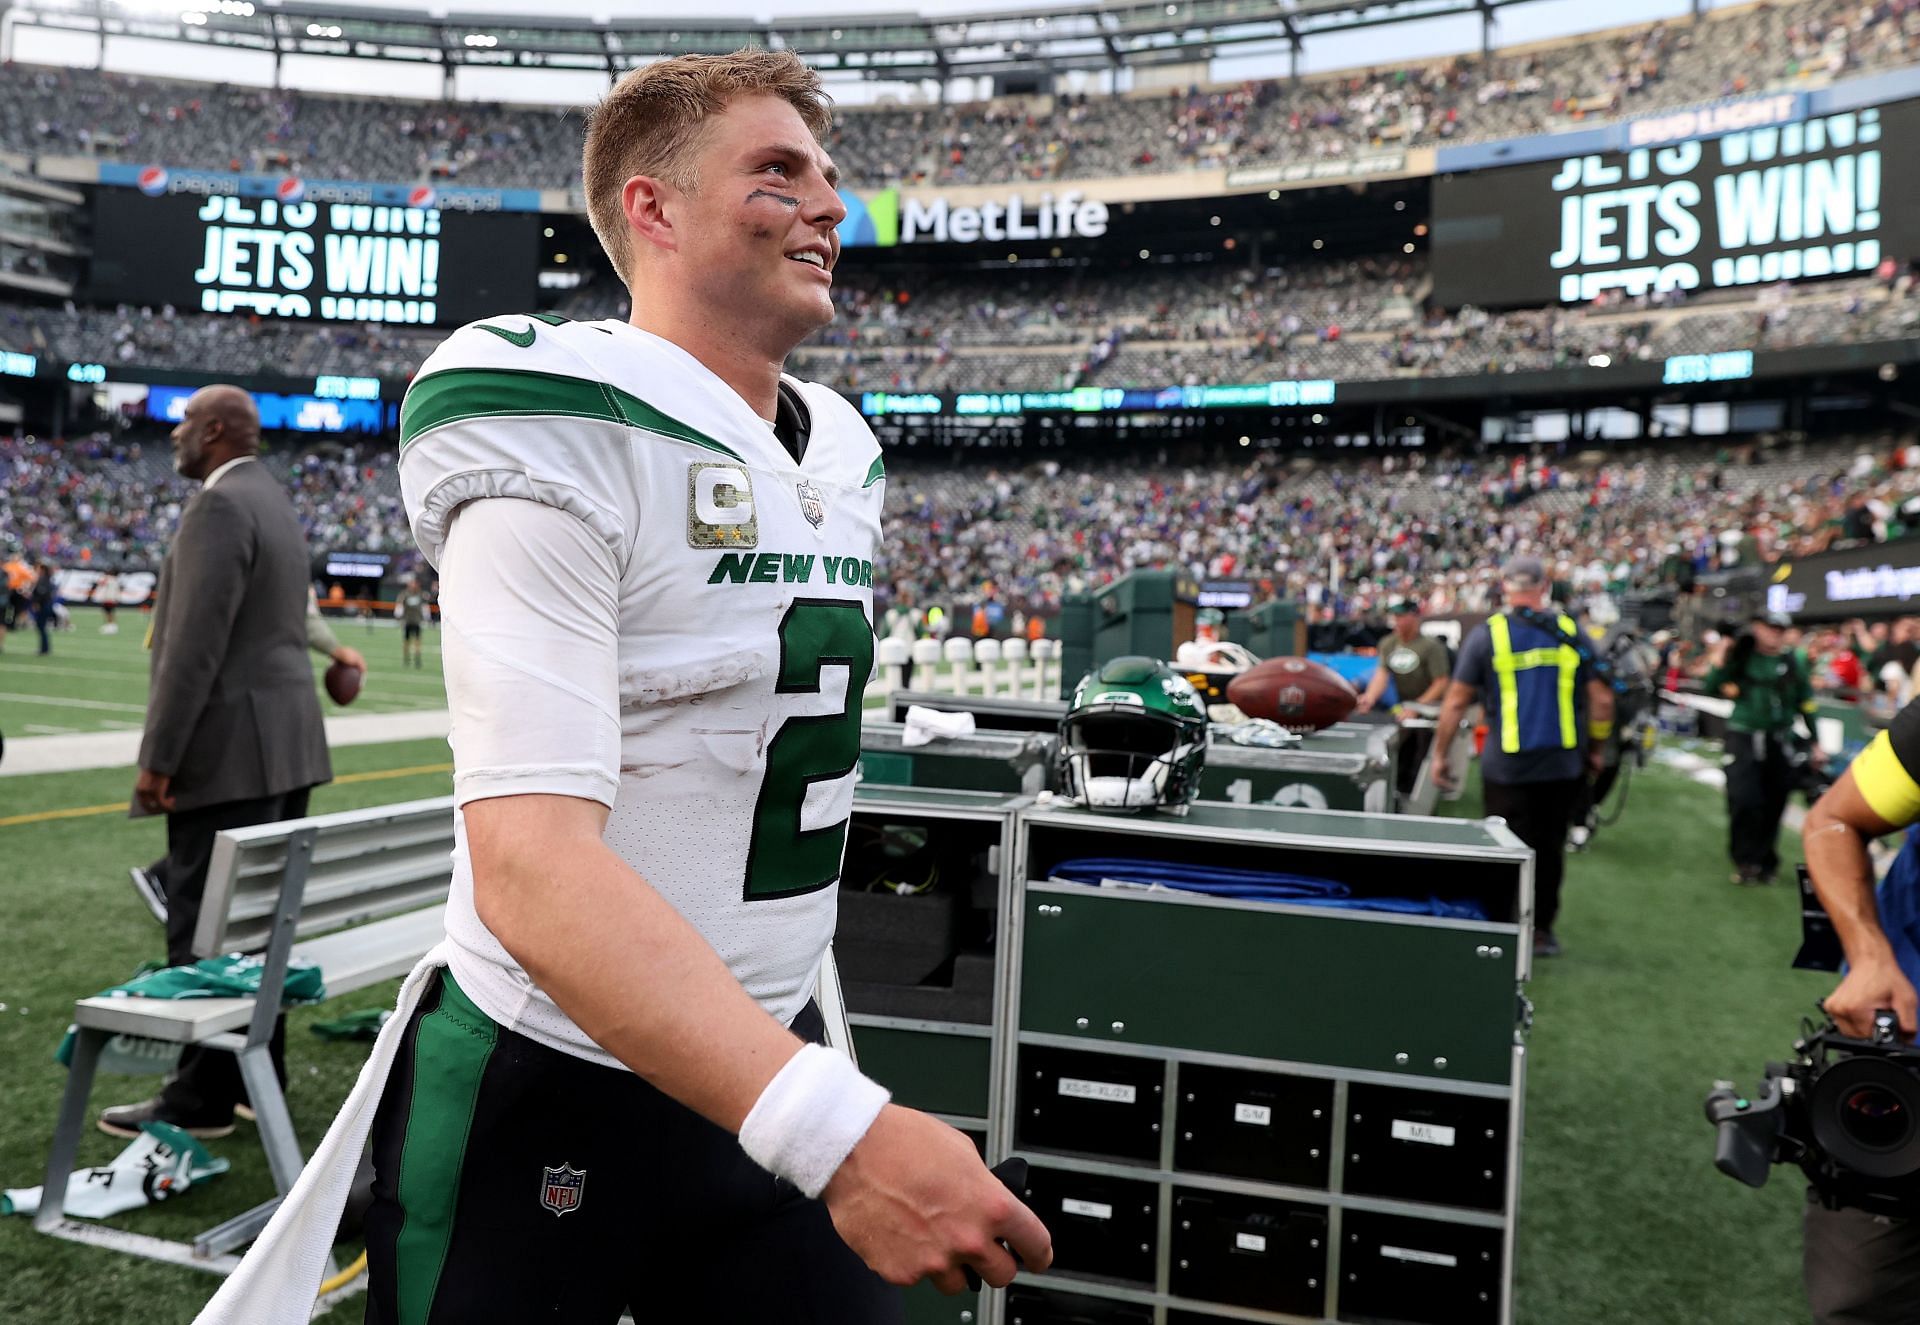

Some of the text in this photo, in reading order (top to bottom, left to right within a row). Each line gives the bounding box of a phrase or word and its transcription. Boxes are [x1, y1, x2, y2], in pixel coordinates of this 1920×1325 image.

[1629, 112, 1696, 146] BUD
[1698, 95, 1796, 135] LIGHT
[168, 173, 240, 196] pepsi
[304, 183, 372, 204] pepsi
[434, 190, 500, 213] pepsi
[901, 190, 1109, 243] MetLife
[1550, 179, 1702, 269] JETS
[1713, 149, 1882, 250] WIN!
[194, 224, 441, 298] JETS WIN!
[695, 467, 753, 525] C
[806, 501, 824, 519] NFL
[707, 553, 816, 584] NEW
[743, 597, 875, 902] 2
[547, 1187, 576, 1208] NFL
